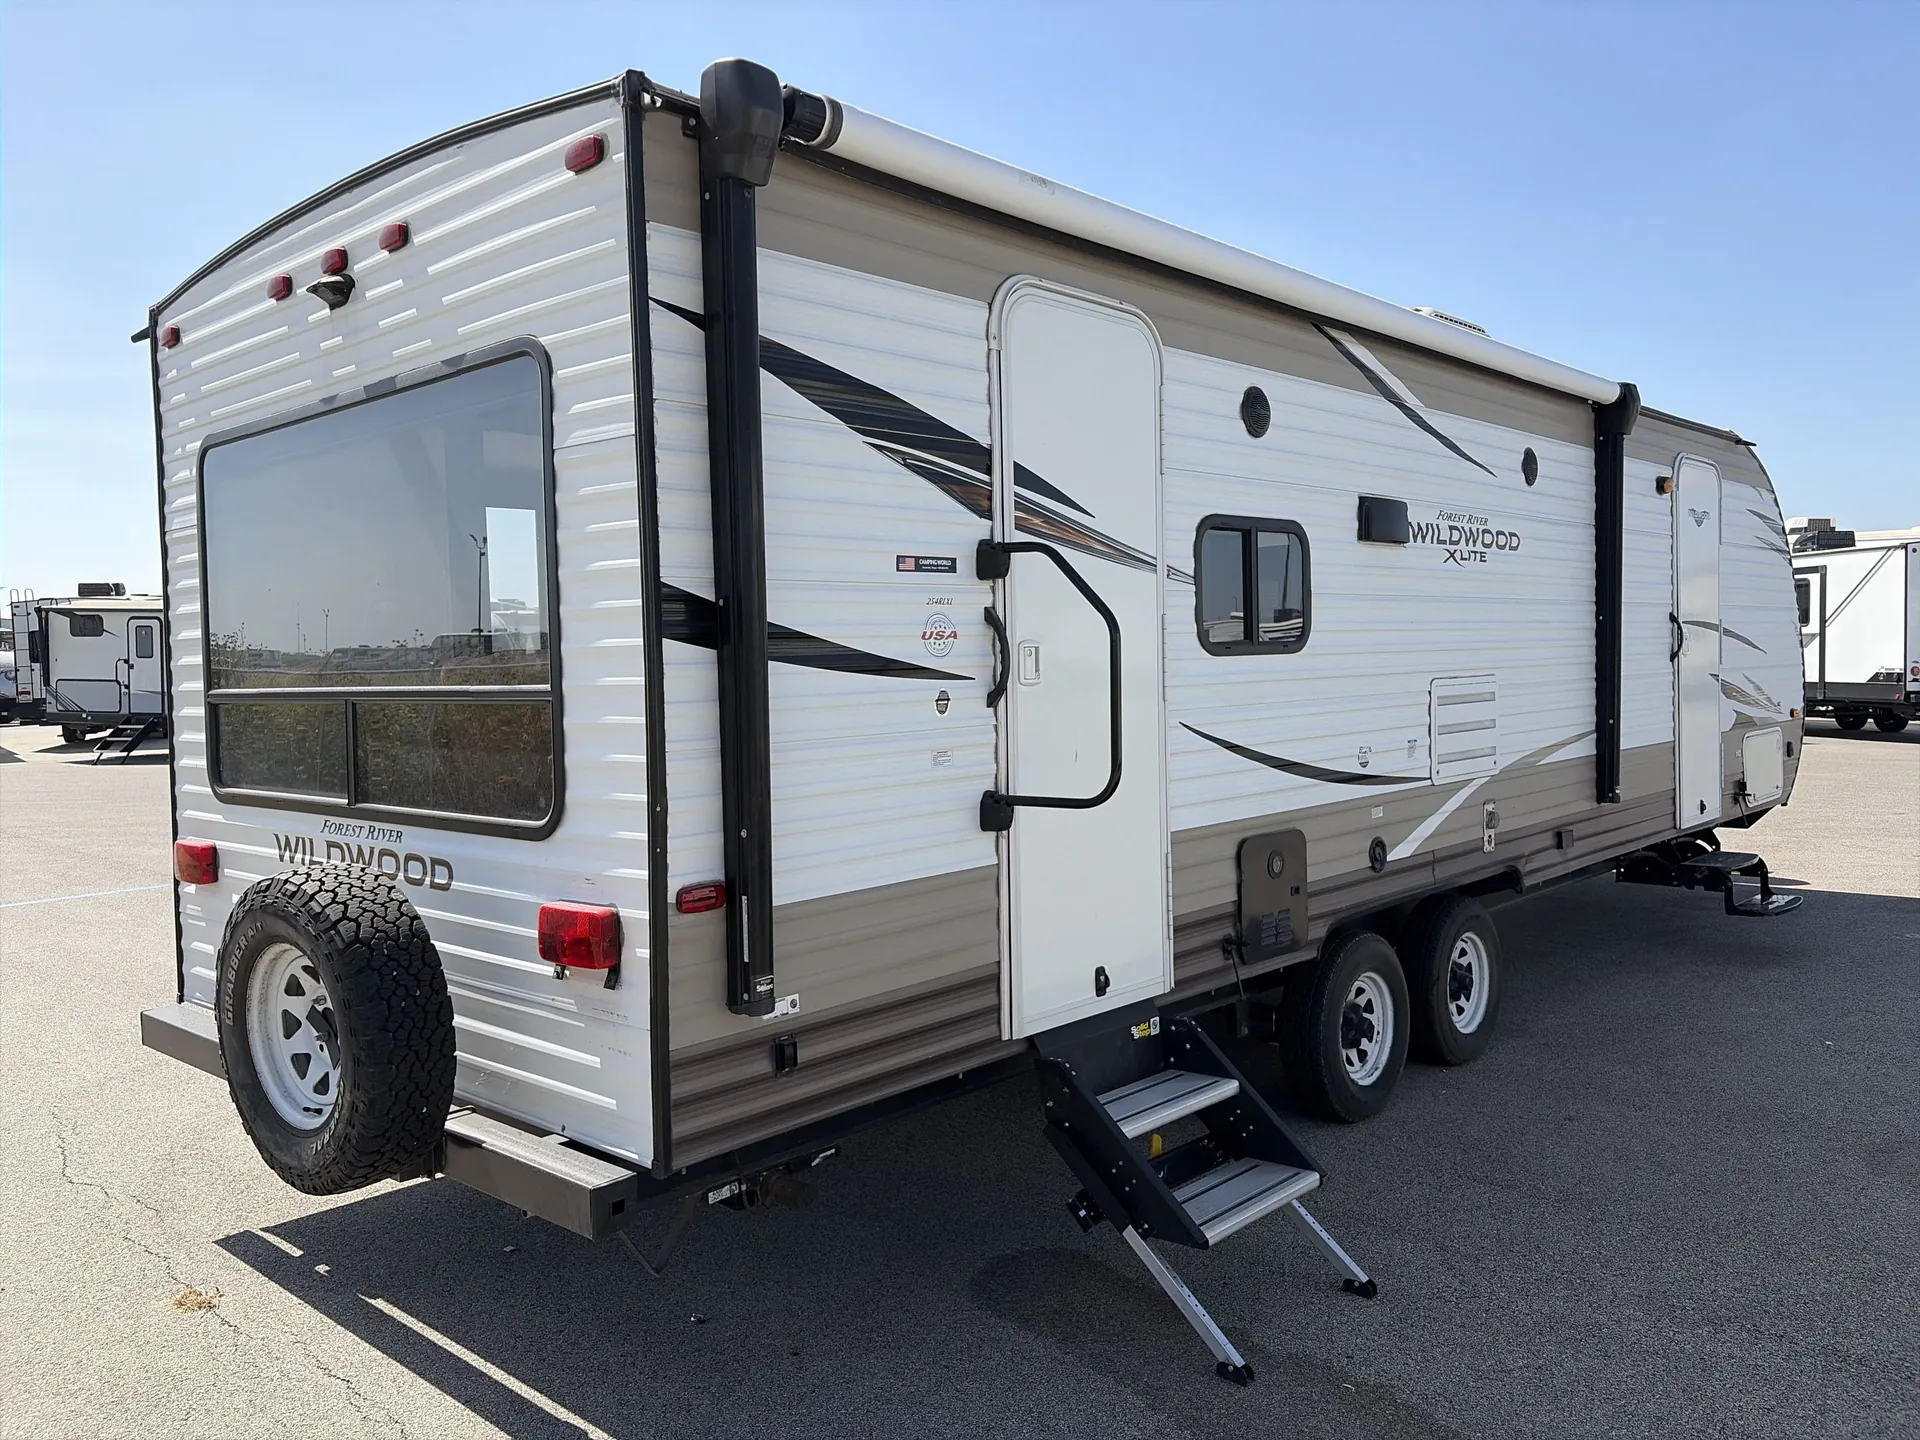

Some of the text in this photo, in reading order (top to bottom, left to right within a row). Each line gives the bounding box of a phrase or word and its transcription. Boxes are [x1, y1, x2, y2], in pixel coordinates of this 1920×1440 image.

[1437, 510, 1489, 526] FOREST RIVER
[1409, 522, 1521, 551] WILDWOOD
[921, 630, 958, 641] USA
[320, 819, 404, 845] FOREST RIVER
[273, 832, 454, 891] WILDWOOD
[225, 933, 250, 1026] GRABBER
[1131, 1021, 1149, 1034] Solid
[1133, 1028, 1151, 1039] Step
